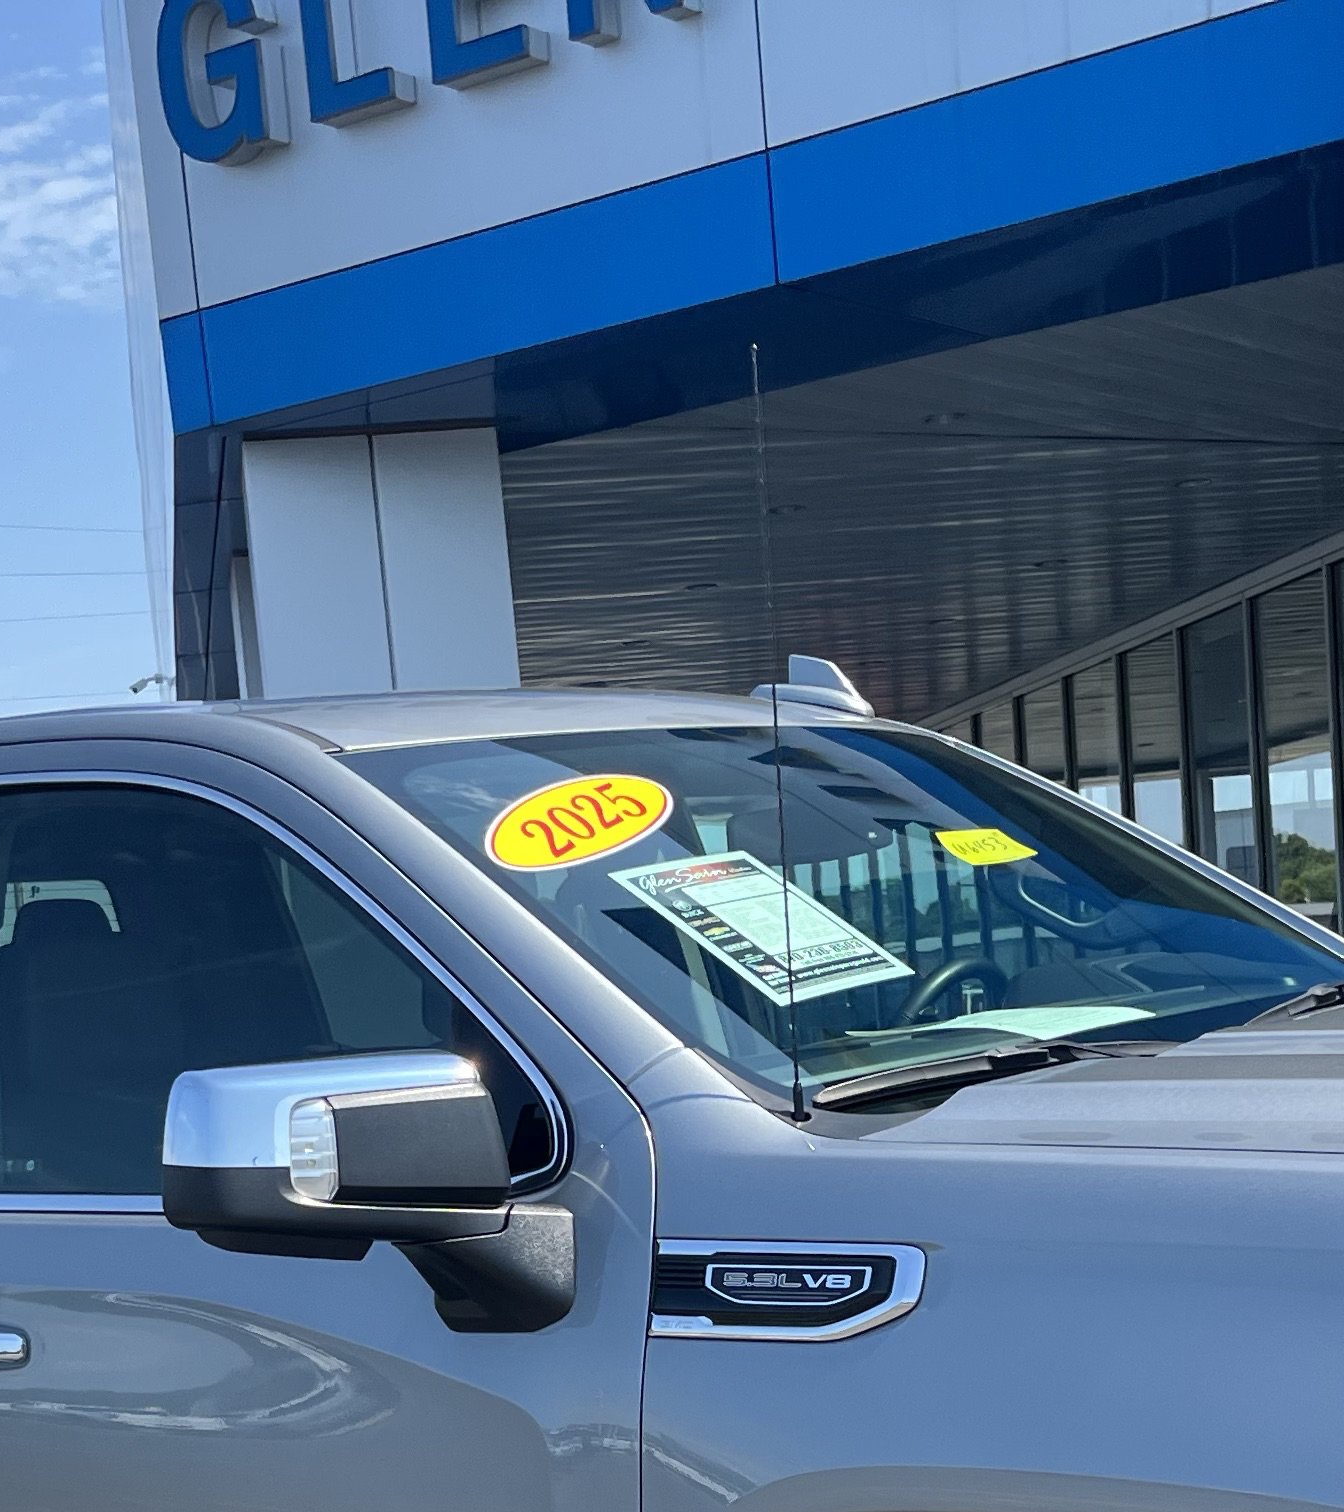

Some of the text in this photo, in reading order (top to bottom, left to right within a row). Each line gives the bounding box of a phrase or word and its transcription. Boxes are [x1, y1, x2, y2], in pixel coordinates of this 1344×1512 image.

[157, 0, 702, 165] GL
[521, 782, 646, 857] 2025
[639, 873, 681, 895] Glen
